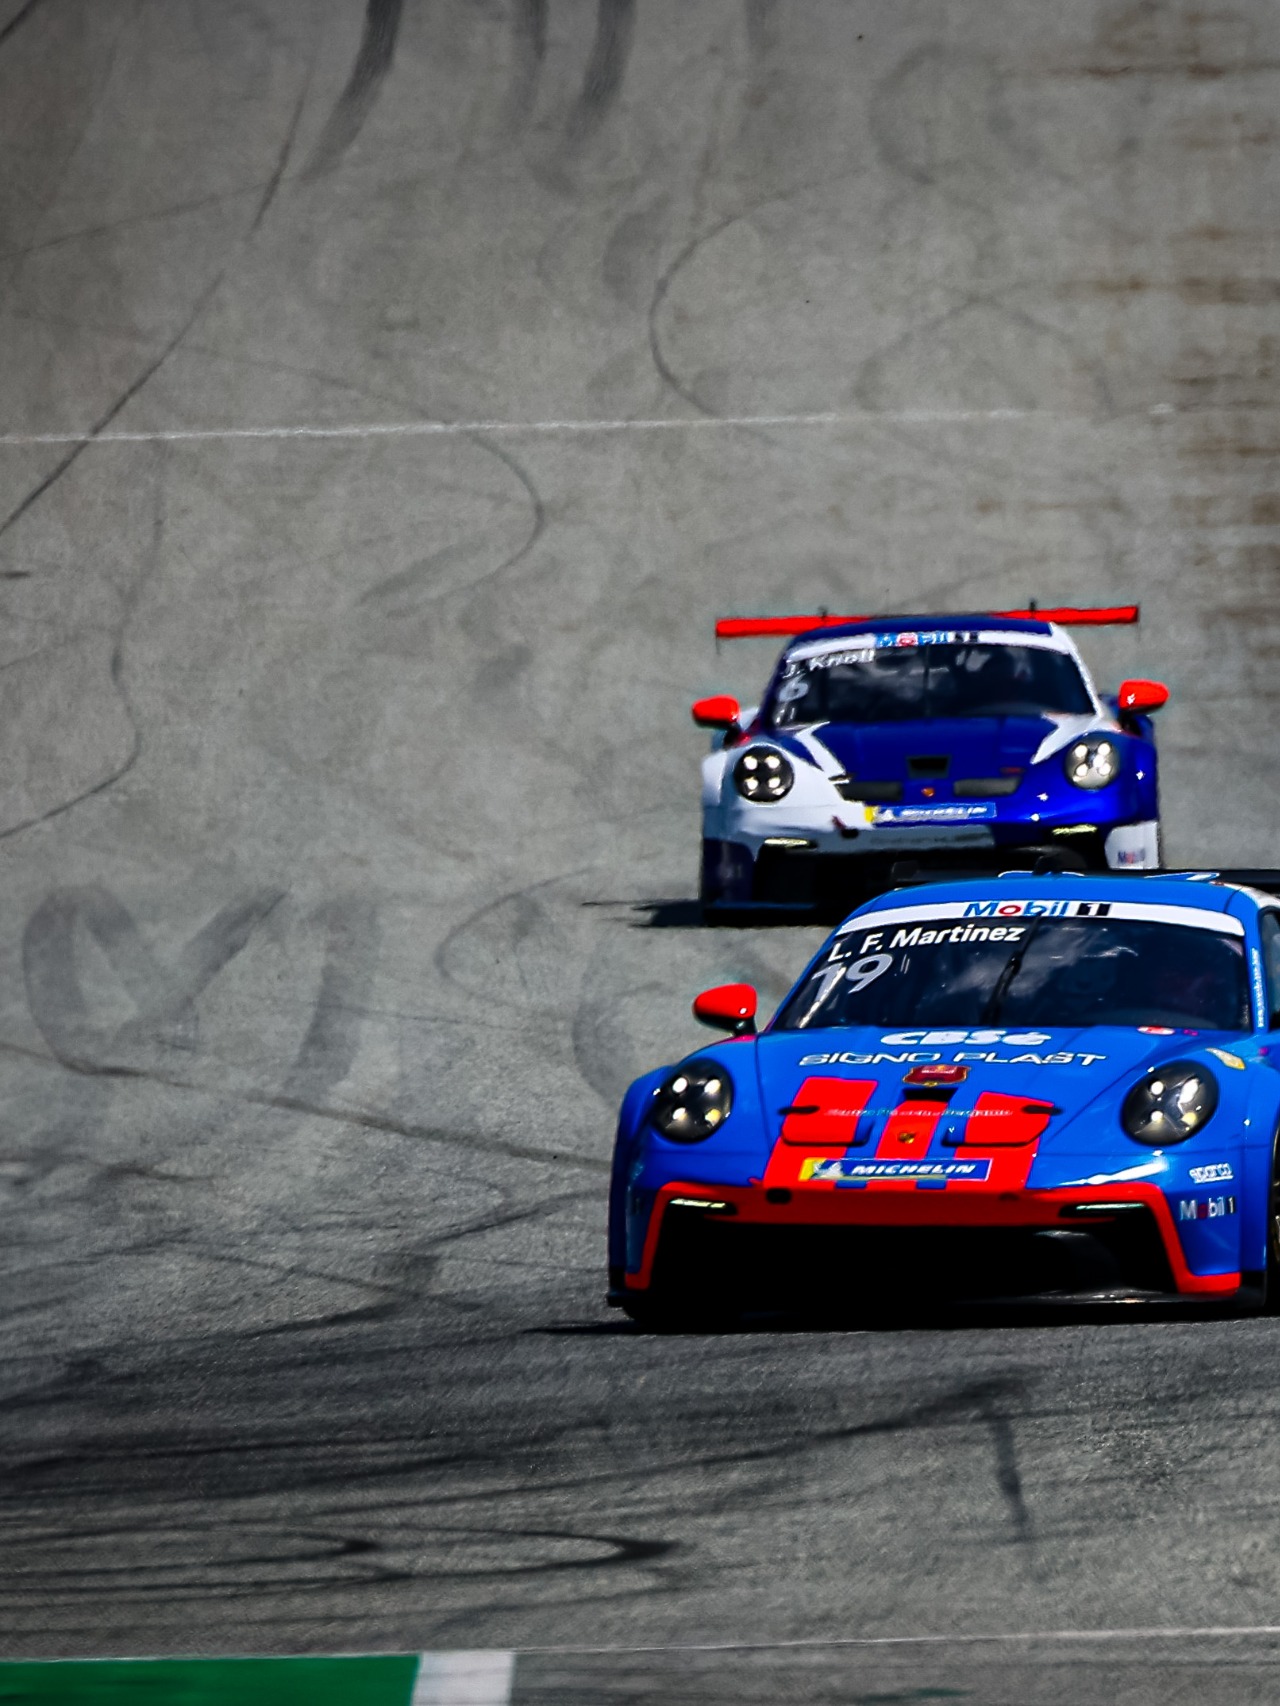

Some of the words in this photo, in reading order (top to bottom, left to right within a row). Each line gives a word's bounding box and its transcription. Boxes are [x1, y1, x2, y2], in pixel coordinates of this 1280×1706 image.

[808, 650, 875, 671] Knoll
[963, 901, 1070, 917] Mobil
[827, 942, 852, 963] L.
[859, 932, 883, 954] F.
[889, 924, 1026, 949] Martinez
[811, 953, 893, 1002] 19
[799, 1052, 941, 1066] SIGNO
[953, 1051, 1107, 1066] PLAST
[851, 1164, 977, 1176] MICHELIN
[1180, 1196, 1225, 1220] Mobil
